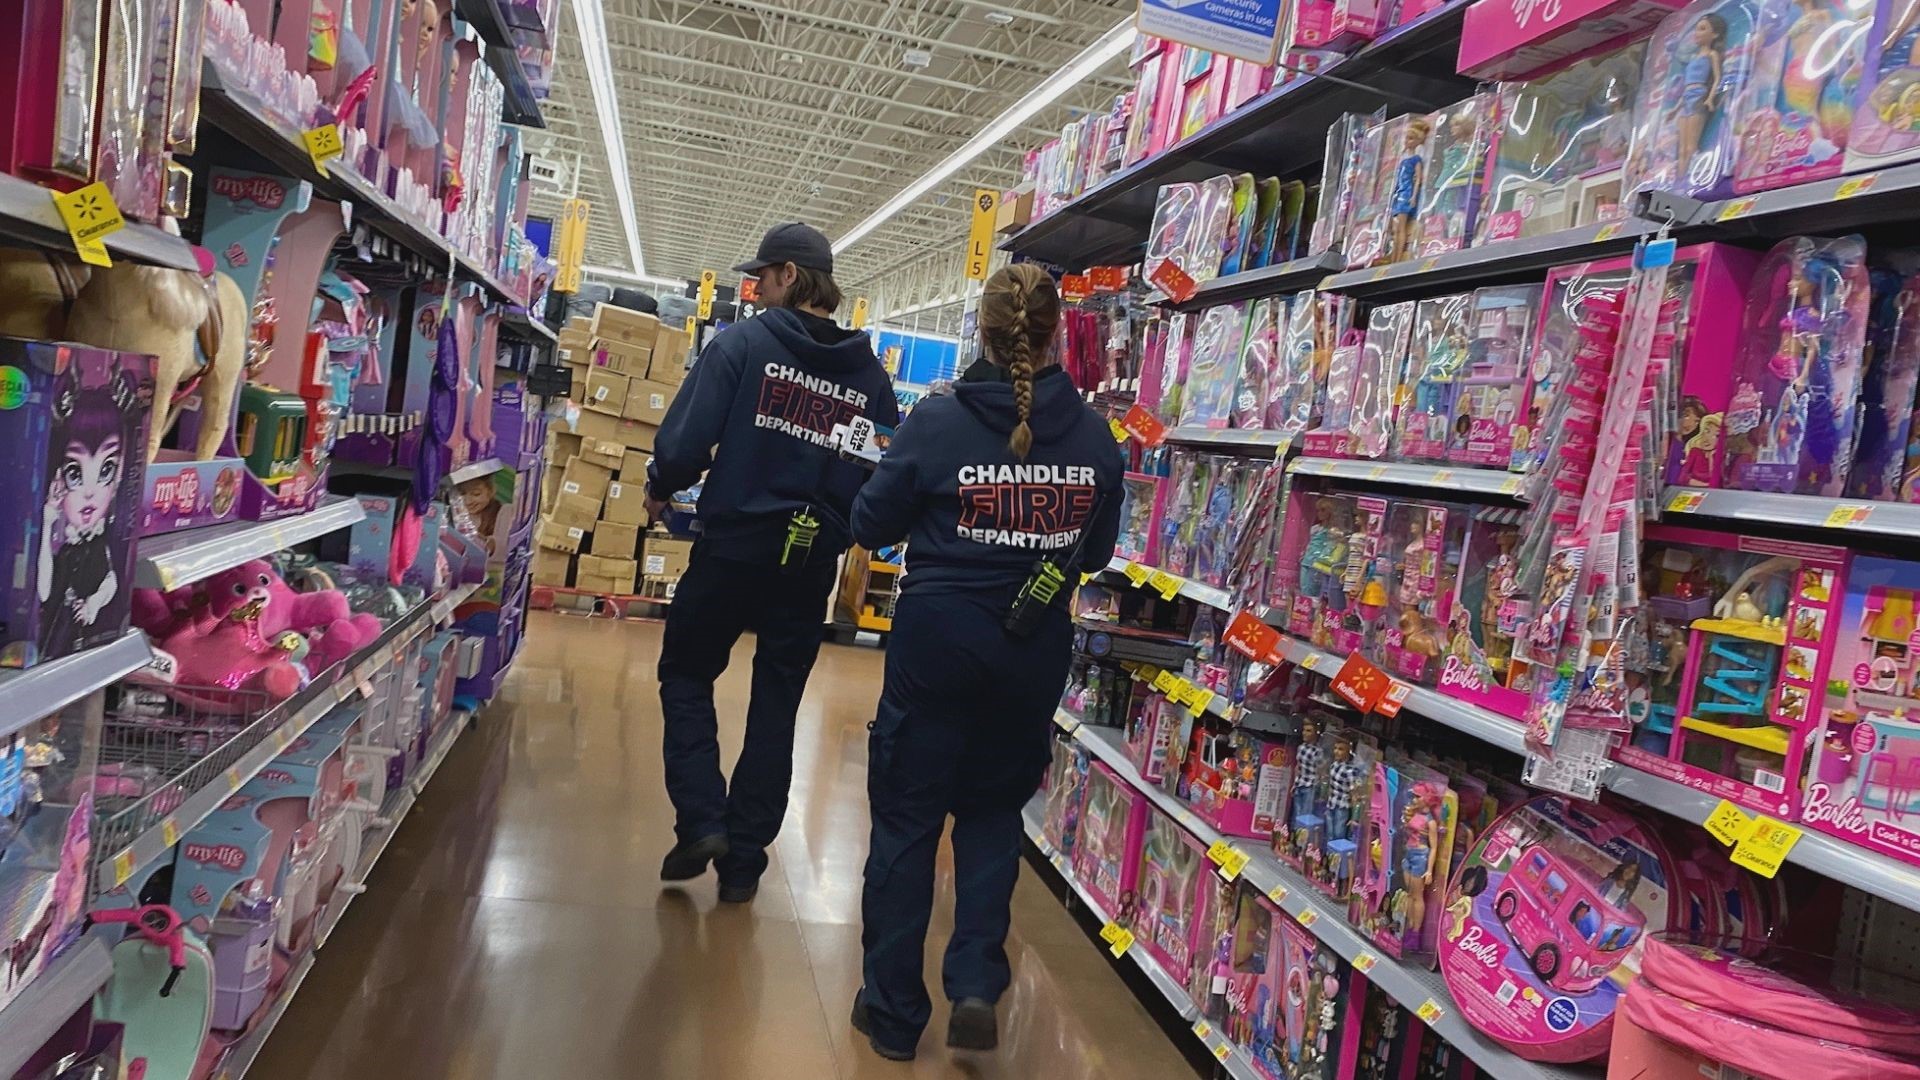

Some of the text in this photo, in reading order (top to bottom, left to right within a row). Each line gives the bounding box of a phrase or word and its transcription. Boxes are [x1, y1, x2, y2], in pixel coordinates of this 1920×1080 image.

[1245, 10, 1255, 22] in
[1255, 15, 1275, 28] use.
[974, 241, 984, 257] L
[558, 273, 564, 287] 6
[570, 273, 577, 288] 6
[972, 261, 982, 276] 5
[764, 362, 868, 410] CHANDLER
[757, 375, 864, 435] FIRE
[849, 420, 864, 451] STAR
[855, 421, 871, 452] WARS
[1469, 420, 1497, 440] Barbie
[957, 464, 1096, 486] CHANDLER
[958, 484, 1096, 533] FIRE
[956, 525, 1082, 550] DEPARTMENT
[1229, 634, 1257, 657] Rollback
[1440, 654, 1481, 690] Barbie
[1337, 681, 1367, 707] Rollback
[1802, 782, 1868, 833] Barbie
[1876, 826, 1900, 844] Cook
[1747, 852, 1776, 871] Clearance
[1458, 925, 1498, 968] Barbie
